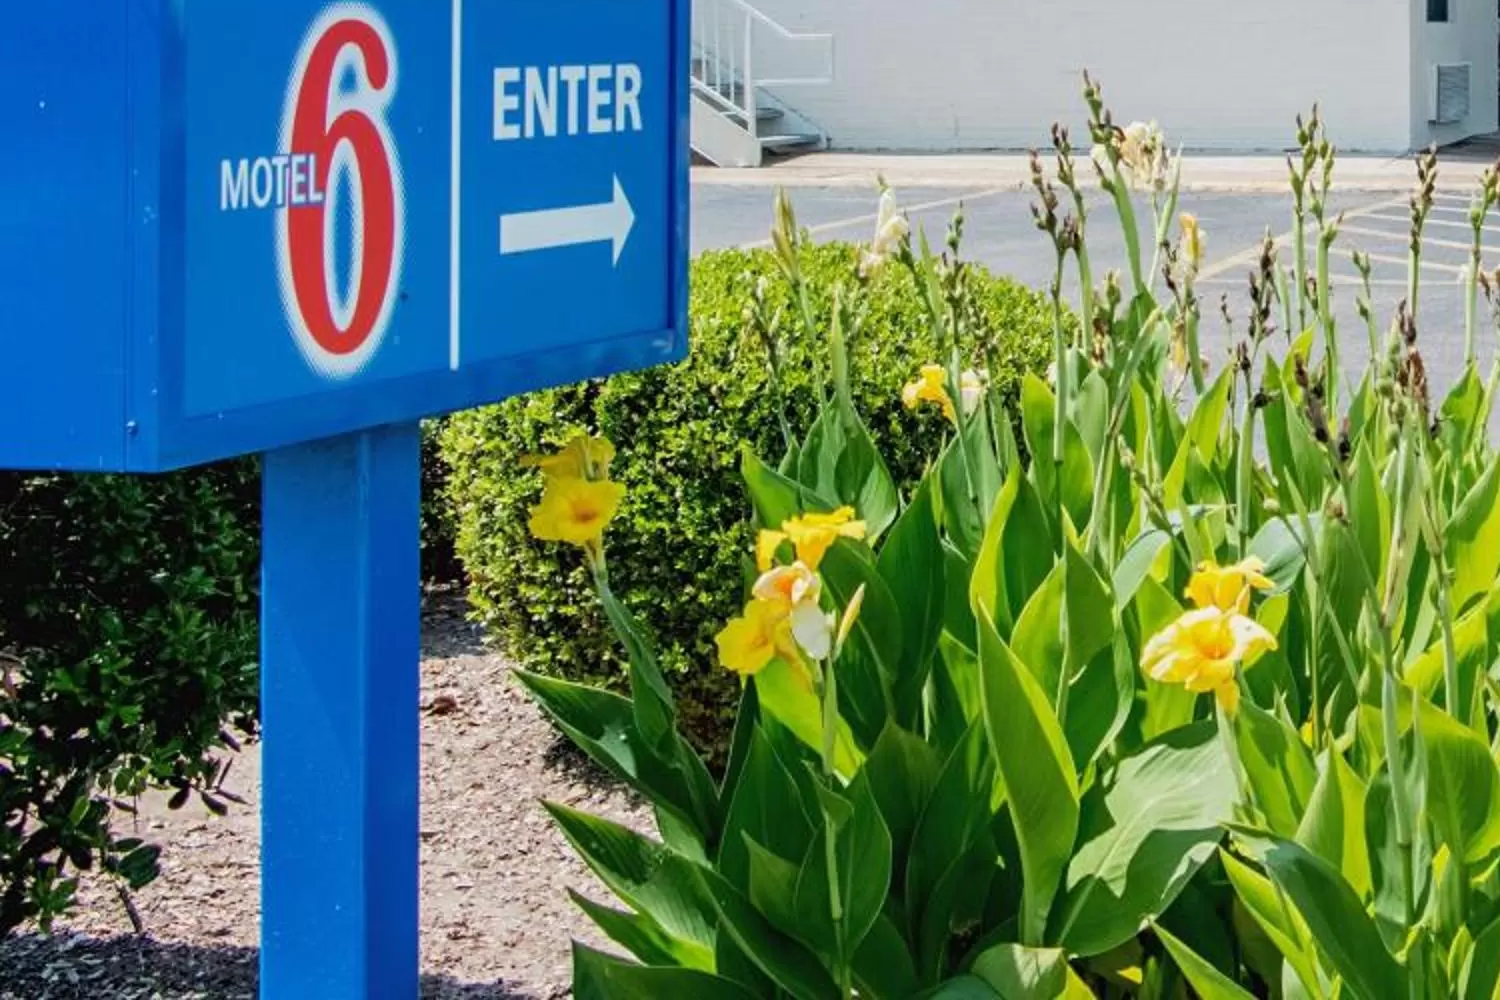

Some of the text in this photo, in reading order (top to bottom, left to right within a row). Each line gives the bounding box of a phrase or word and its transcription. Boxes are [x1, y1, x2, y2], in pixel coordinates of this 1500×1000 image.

[220, 11, 400, 365] MOTEL 6
[492, 63, 643, 140] ENTER
